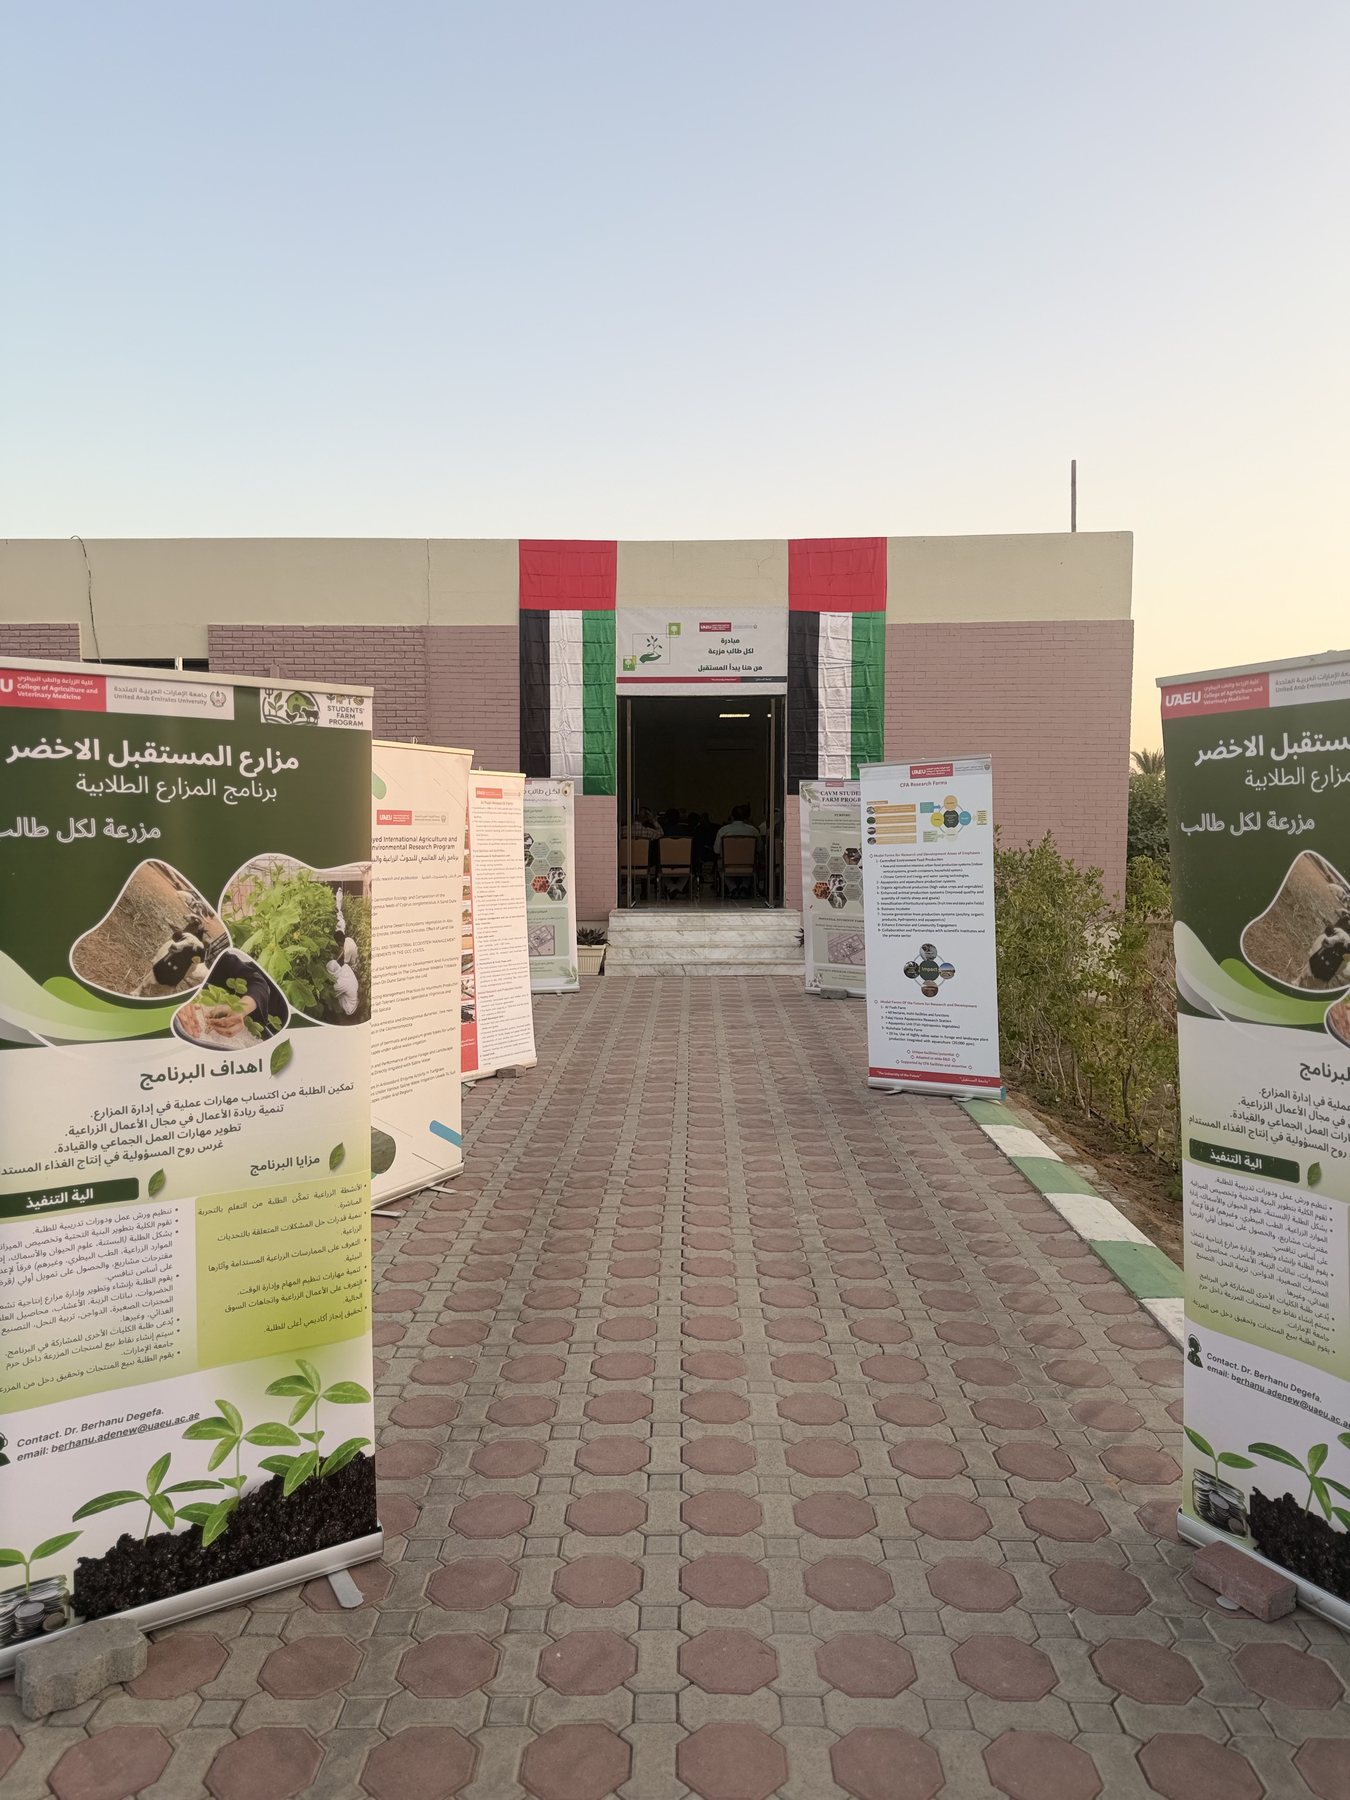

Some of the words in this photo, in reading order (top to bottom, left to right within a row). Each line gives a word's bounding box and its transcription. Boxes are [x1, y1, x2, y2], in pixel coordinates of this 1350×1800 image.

[721, 637, 740, 646] مبادرة
[708, 648, 726, 656] مزرعة
[743, 648, 754, 656] لكل
[697, 664, 728, 673] المستقبل
[729, 662, 741, 672] يبدأ
[17, 683, 40, 691] College
[49, 685, 85, 694] Agriculture
[61, 678, 80, 686] الزراعة
[17, 690, 50, 700] Veterinary
[52, 692, 81, 700] Medicine
[139, 687, 162, 696] العربية
[189, 691, 207, 699] جامعة
[1204, 691, 1220, 699] College
[1226, 688, 1252, 697] Agriculture
[177, 698, 207, 706] University
[1165, 691, 1201, 707] UAEU
[1204, 697, 1227, 705] Veterinary
[328, 719, 364, 727] PROGRAM
[6, 737, 100, 763] الاخضر
[108, 740, 232, 768] المستقبل
[1194, 734, 1264, 767] الاخضر
[239, 748, 299, 777] مزارع
[76, 773, 148, 796] الطلابية
[1244, 766, 1305, 791] الطلابية
[156, 777, 216, 803] المزارع
[223, 780, 277, 805] برنامج
[1180, 812, 1225, 836] طالب
[1230, 811, 1261, 836] لكل
[1266, 810, 1315, 835] مزرعة
[57, 817, 96, 843] لكل
[103, 817, 161, 843] مزرعة
[419, 836, 448, 844] Agriculture
[433, 843, 455, 851] Program
[210, 1058, 262, 1077] اهداف
[140, 1063, 205, 1090] البرنامج
[281, 1091, 296, 1100] من
[299, 1085, 326, 1097] الطلبة
[328, 1082, 354, 1095] تمكين
[1258, 1087, 1291, 1099] المزارع.
[204, 1095, 239, 1107] مهارات
[241, 1090, 279, 1102] اكتساب
[1292, 1090, 1311, 1106] إدارة
[1313, 1097, 1326, 1109] في
[131, 1103, 154, 1116] إدارة
[157, 1101, 171, 1116] في
[173, 1098, 201, 1111] عملية
[259, 1104, 284, 1116] تنمية
[1238, 1096, 1273, 1111] الزراعية.
[1275, 1103, 1307, 1117] الأعمال
[90, 1105, 128, 1121] المزارع.
[196, 1109, 231, 1124] الأعمال
[233, 1107, 256, 1119] ريادة
[1230, 1109, 1266, 1126] والقيادة.
[1308, 1110, 1330, 1122] مجال
[110, 1118, 148, 1133] الأعمال
[150, 1117, 177, 1129] مجال
[179, 1115, 194, 1128] في
[1222, 1122, 1247, 1134] الغذاء
[1267, 1117, 1303, 1131] الجماعي
[1332, 1115, 1346, 1129] في
[65, 1123, 107, 1137] الزراعية.
[177, 1128, 212, 1140] مهارات
[214, 1123, 242, 1137] تطوير
[1248, 1128, 1269, 1142] إنتاج
[1304, 1124, 1329, 1137] العمل
[100, 1135, 143, 1150] الجماعي
[145, 1130, 175, 1145] العمل
[1270, 1132, 1284, 1145] في
[1286, 1134, 1329, 1152] المسؤولية
[54, 1140, 98, 1154] والقيادة.
[177, 1146, 195, 1158] روح
[197, 1139, 224, 1153] غرس
[1330, 1146, 1347, 1159] روح
[104, 1152, 120, 1167] في
[122, 1146, 175, 1162] المسؤولية
[1210, 1148, 1242, 1165] التنفيذ
[44, 1157, 75, 1171] الغذاء
[77, 1154, 102, 1170] إنتاج
[250, 1157, 293, 1176] البرنامج
[296, 1155, 321, 1169] مزايا
[1244, 1157, 1263, 1170] الية
[26, 1191, 69, 1210] التنفيذ
[71, 1188, 94, 1202] الية
[114, 1214, 131, 1224] عمل
[1206, 1352, 1239, 1371] Contact.
[1240, 1365, 1253, 1375] Dr.
[1253, 1370, 1289, 1389] Berhanu
[1290, 1383, 1322, 1403] Degefa.
[1206, 1365, 1230, 1379] email:
[1231, 1373, 1350, 1430] berhanu.adenew@uaeu.ac.a
[17, 1430, 62, 1448] Contact.
[64, 1427, 78, 1436] Dr.
[81, 1416, 124, 1433] Berhanu
[126, 1408, 164, 1423] Degefa.
[17, 1447, 49, 1462] email:
[51, 1412, 200, 1453] berhanu.adenew@uaeu.ac.ae
